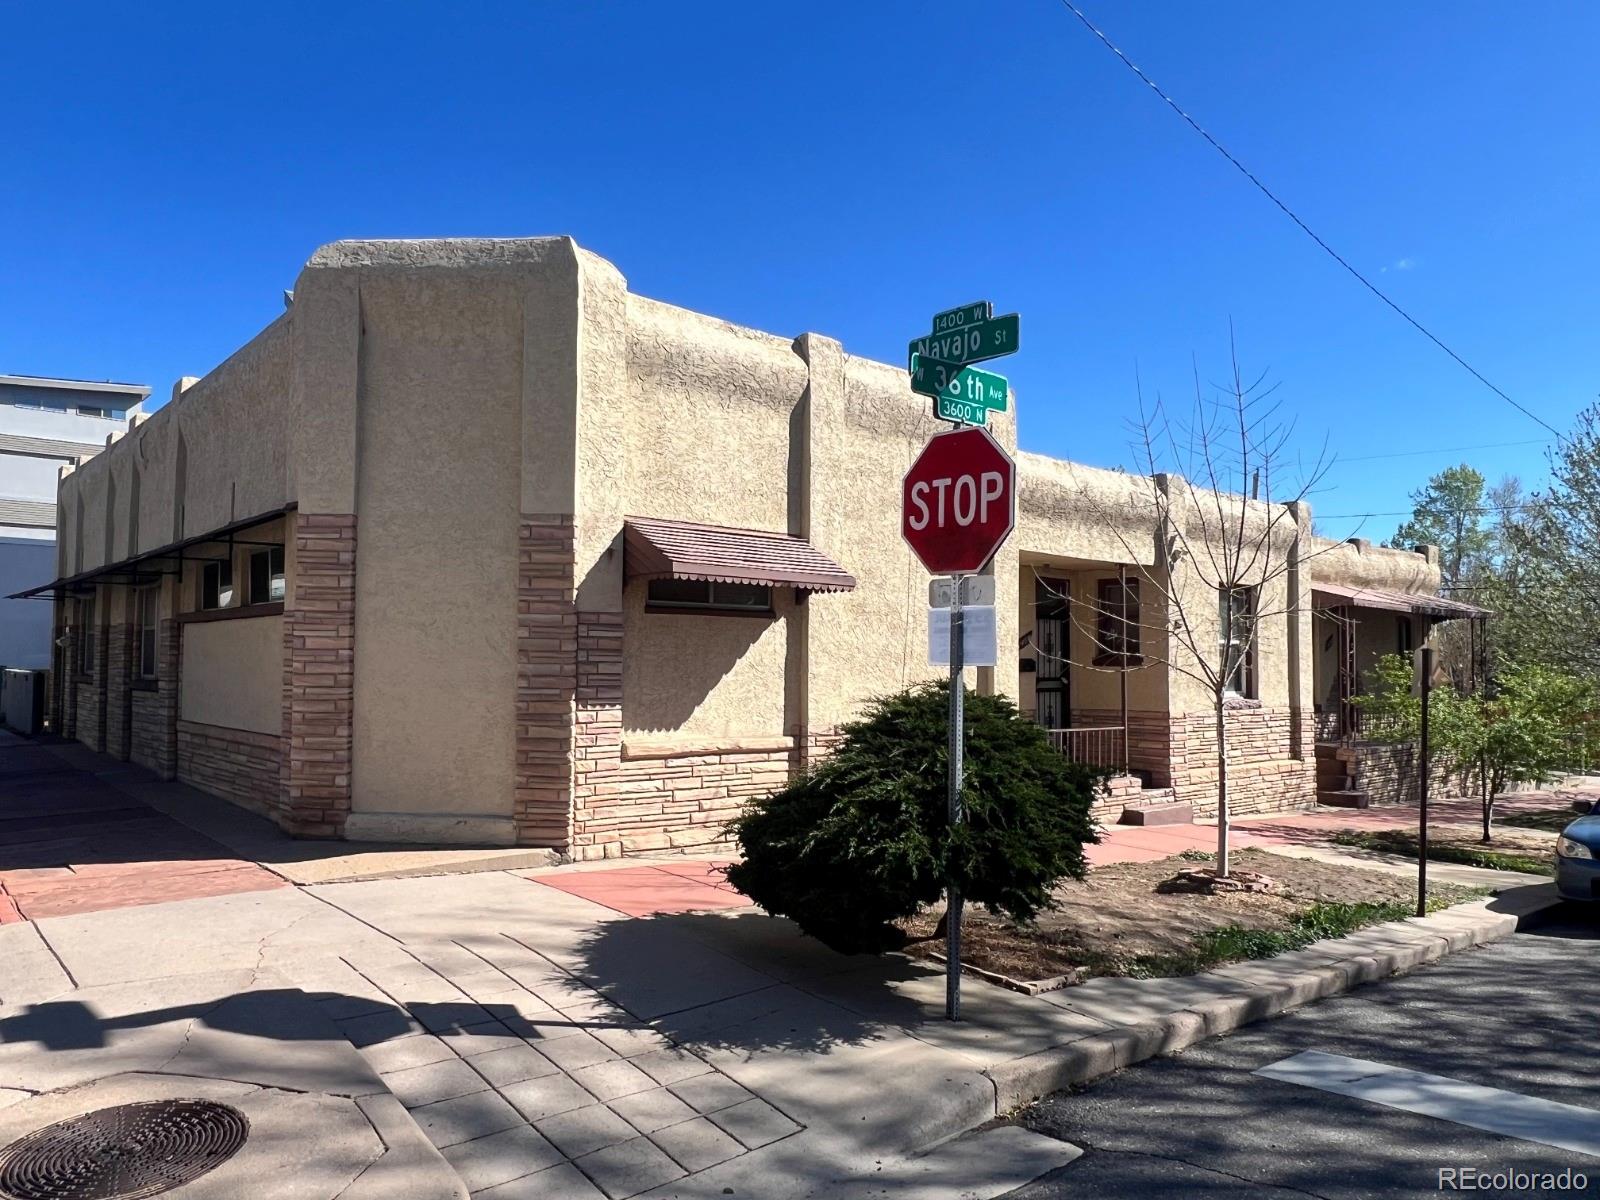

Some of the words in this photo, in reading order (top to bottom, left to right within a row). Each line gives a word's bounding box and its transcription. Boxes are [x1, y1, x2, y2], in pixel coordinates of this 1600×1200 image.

[936, 312, 964, 330] 1400
[973, 306, 983, 320] W
[918, 327, 981, 361] Navajo
[994, 329, 1007, 345] St
[934, 365, 984, 401] 36th
[989, 386, 1003, 401] Ave
[943, 401, 971, 418] 3600
[976, 409, 983, 422] N
[909, 471, 1004, 531] STOP
